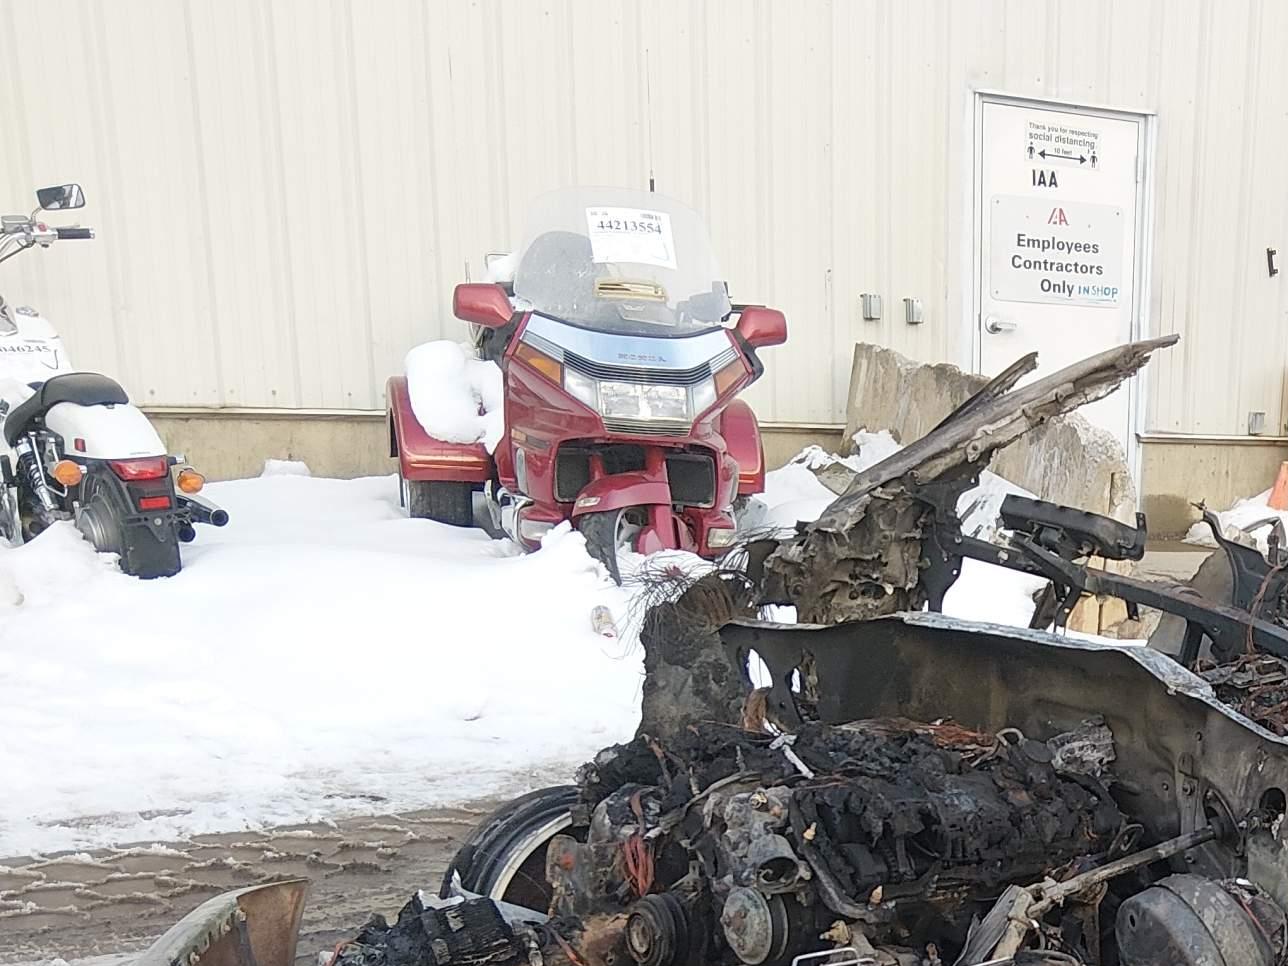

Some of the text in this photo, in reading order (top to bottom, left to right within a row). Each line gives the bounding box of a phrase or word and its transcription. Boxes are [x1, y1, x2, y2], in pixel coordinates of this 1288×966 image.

[1028, 131, 1095, 150] social distancing
[1068, 128, 1099, 139] respecting
[1032, 169, 1058, 188] IAA
[596, 220, 662, 234] 44213554
[1016, 233, 1099, 254] Employees
[1011, 254, 1104, 275] Contractors
[1040, 278, 1074, 297] Only
